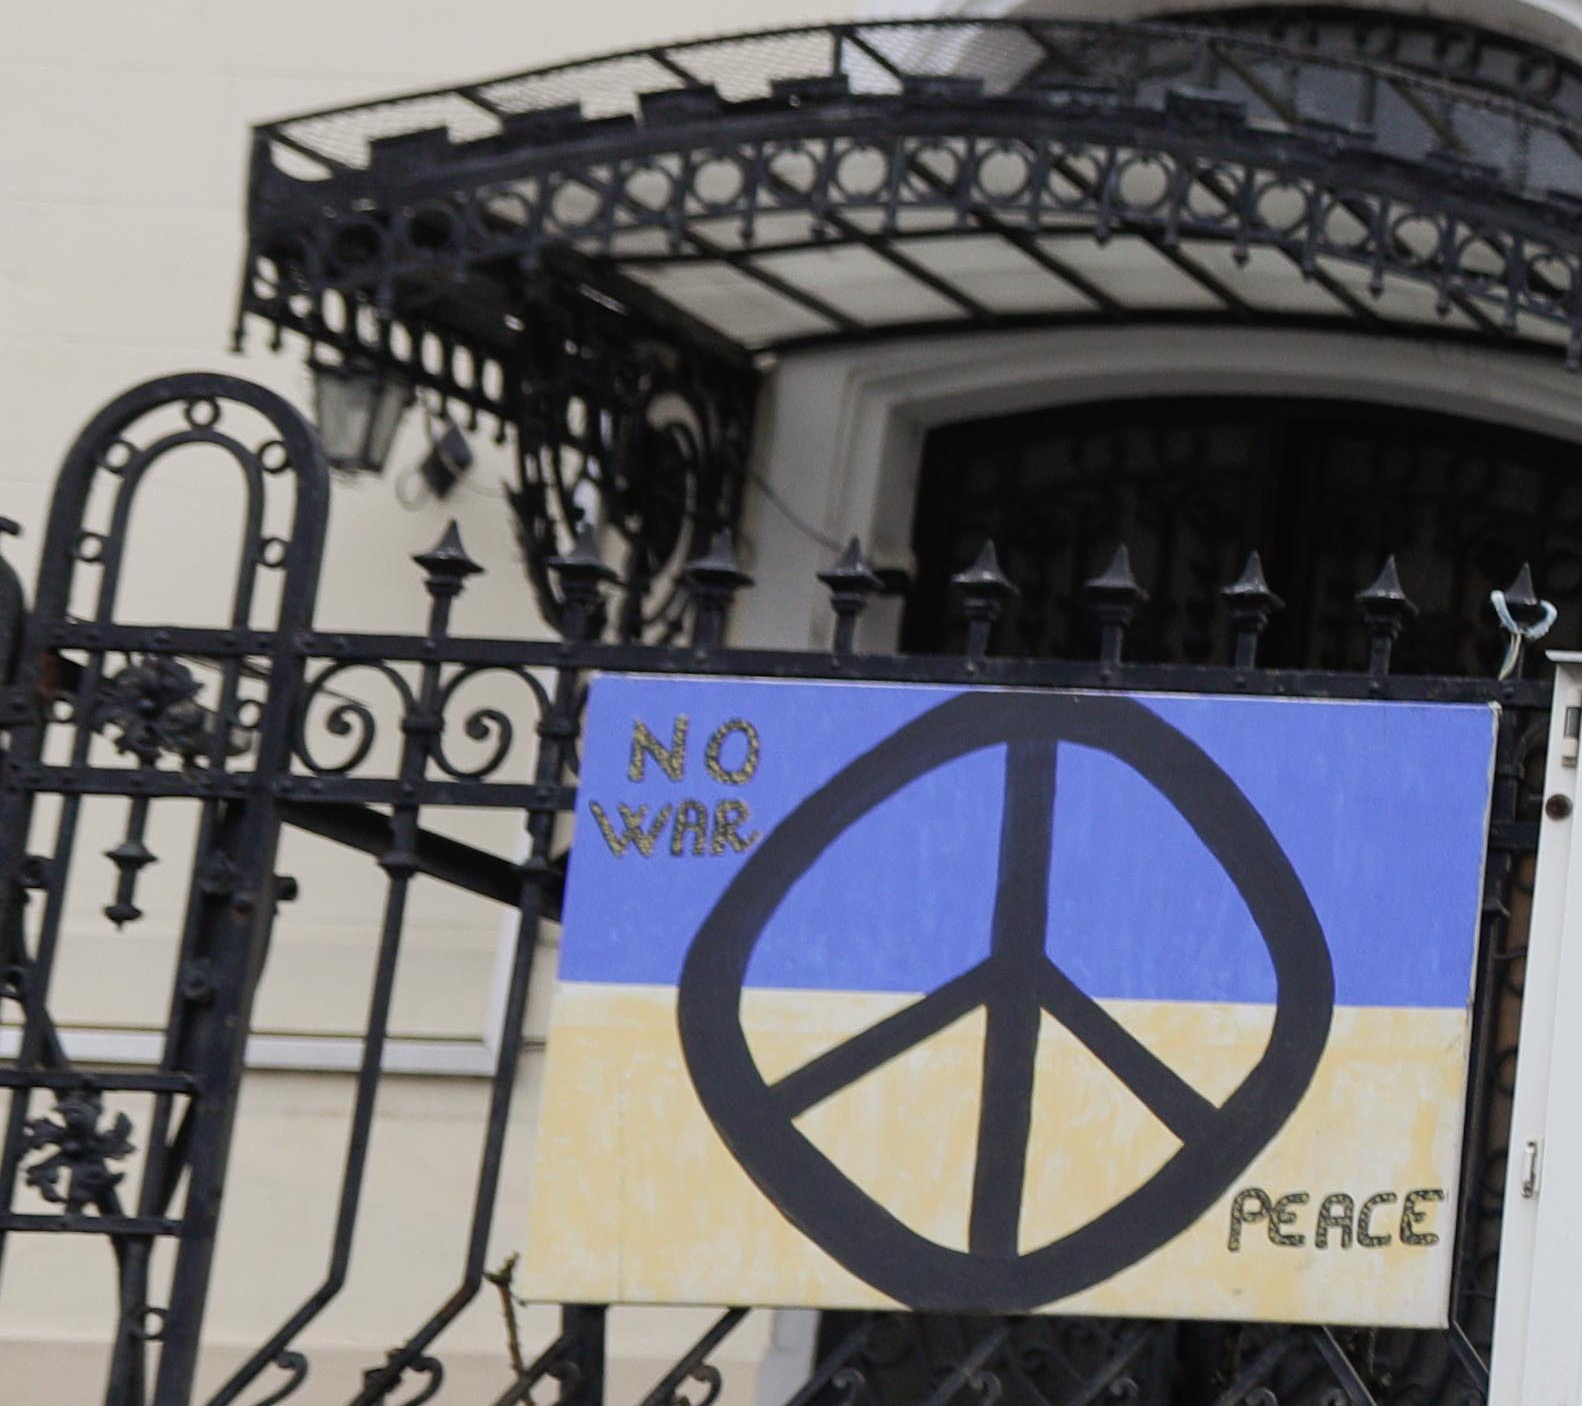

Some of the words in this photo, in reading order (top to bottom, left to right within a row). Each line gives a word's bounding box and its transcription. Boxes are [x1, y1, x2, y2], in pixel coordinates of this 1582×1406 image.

[628, 715, 760, 786] NO
[589, 799, 761, 859] WAR
[1226, 1187, 1444, 1253] PEACE
